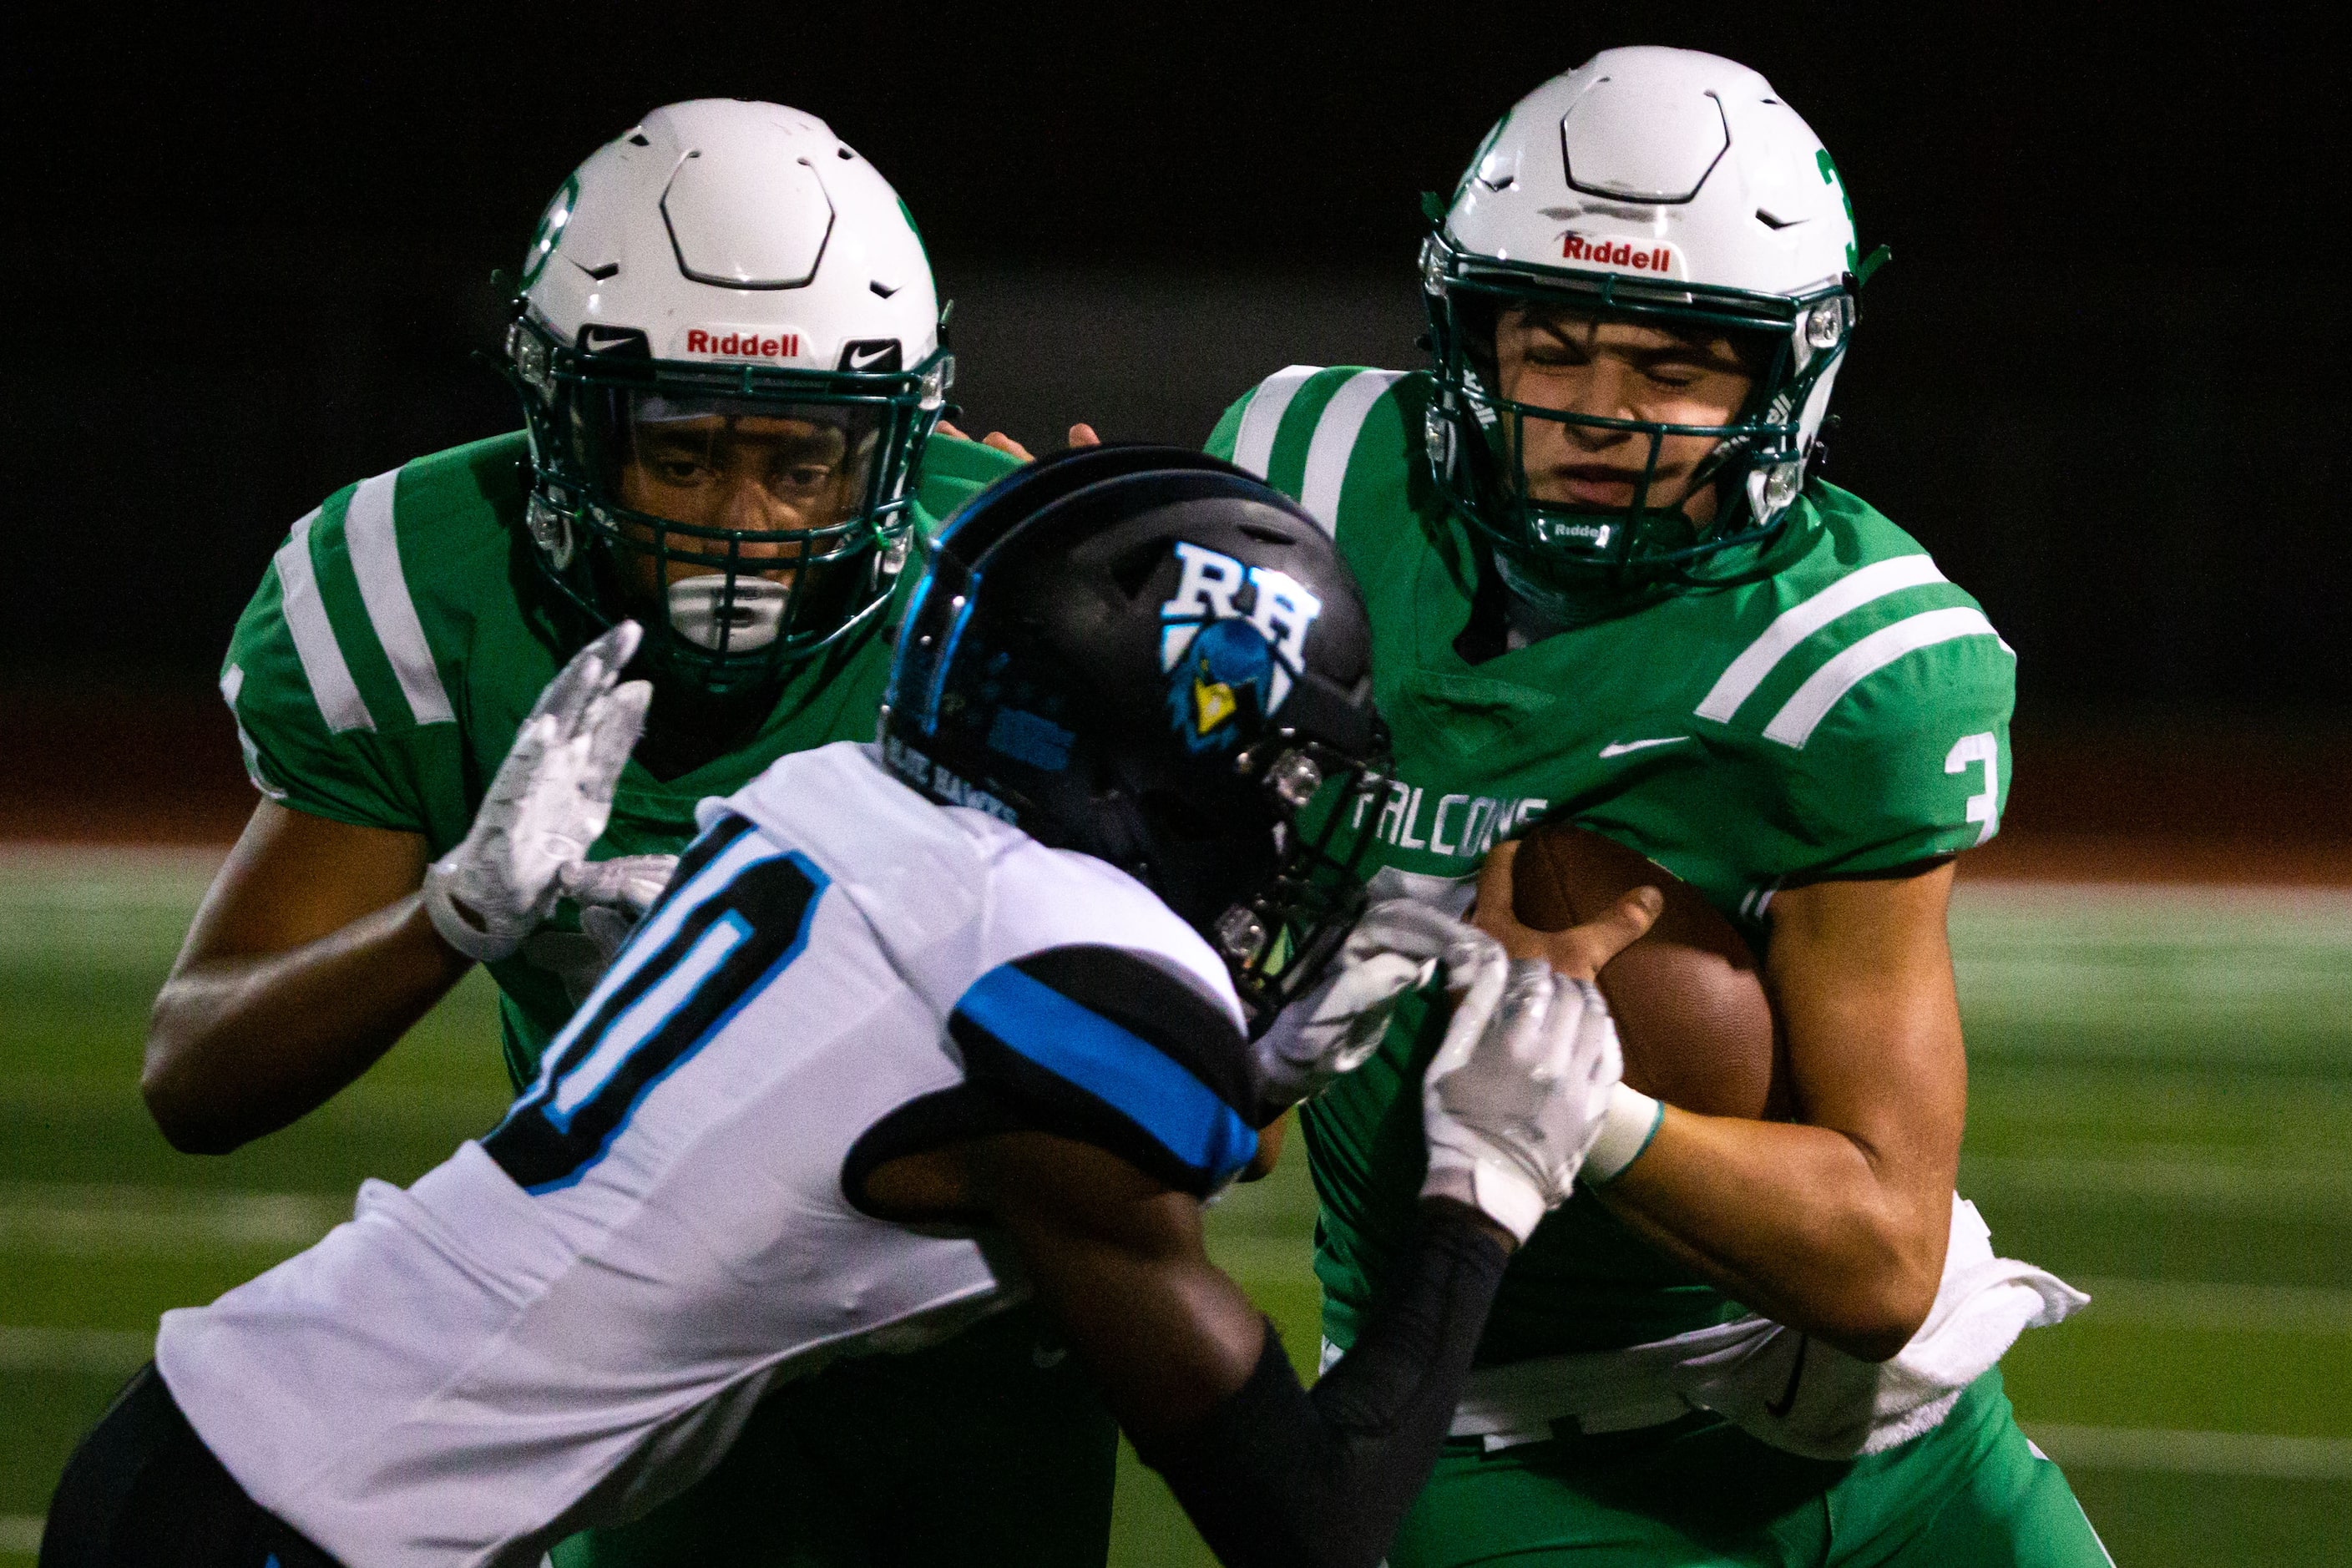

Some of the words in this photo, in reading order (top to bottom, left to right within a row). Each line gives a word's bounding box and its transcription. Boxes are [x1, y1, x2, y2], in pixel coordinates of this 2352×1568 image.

[1563, 235, 1670, 272] Riddell
[687, 328, 799, 357] Riddell
[1555, 523, 1610, 539] Ridde
[1945, 731, 1998, 847] 3
